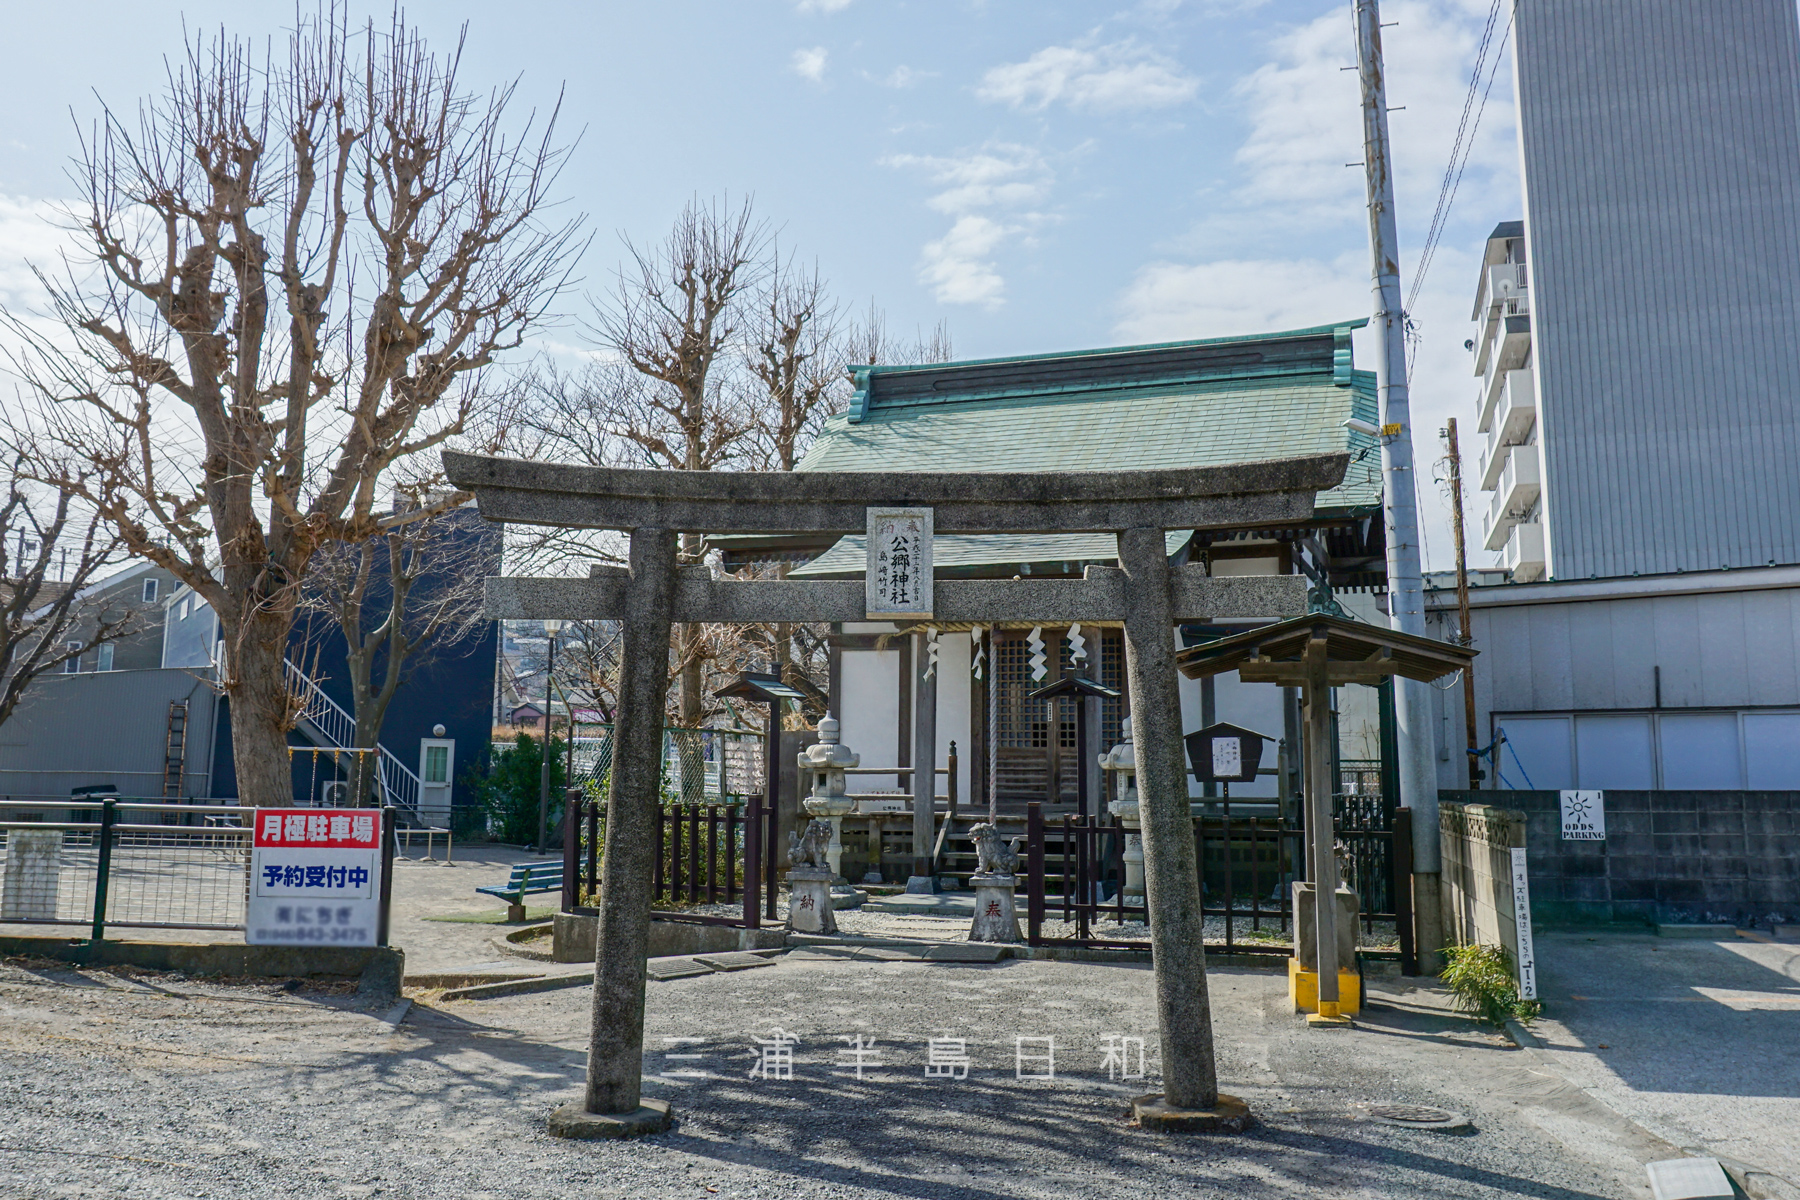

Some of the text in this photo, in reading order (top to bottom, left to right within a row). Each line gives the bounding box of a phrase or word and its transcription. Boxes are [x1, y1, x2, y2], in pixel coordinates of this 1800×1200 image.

[889, 536, 910, 604] 公郷神社
[261, 815, 373, 842] 月極駐車場
[1563, 831, 1605, 839] PARKING
[1565, 823, 1594, 831] ODDS
[262, 865, 369, 888] 予約受付中
[800, 894, 815, 911] 納
[985, 901, 1002, 918] 奉
